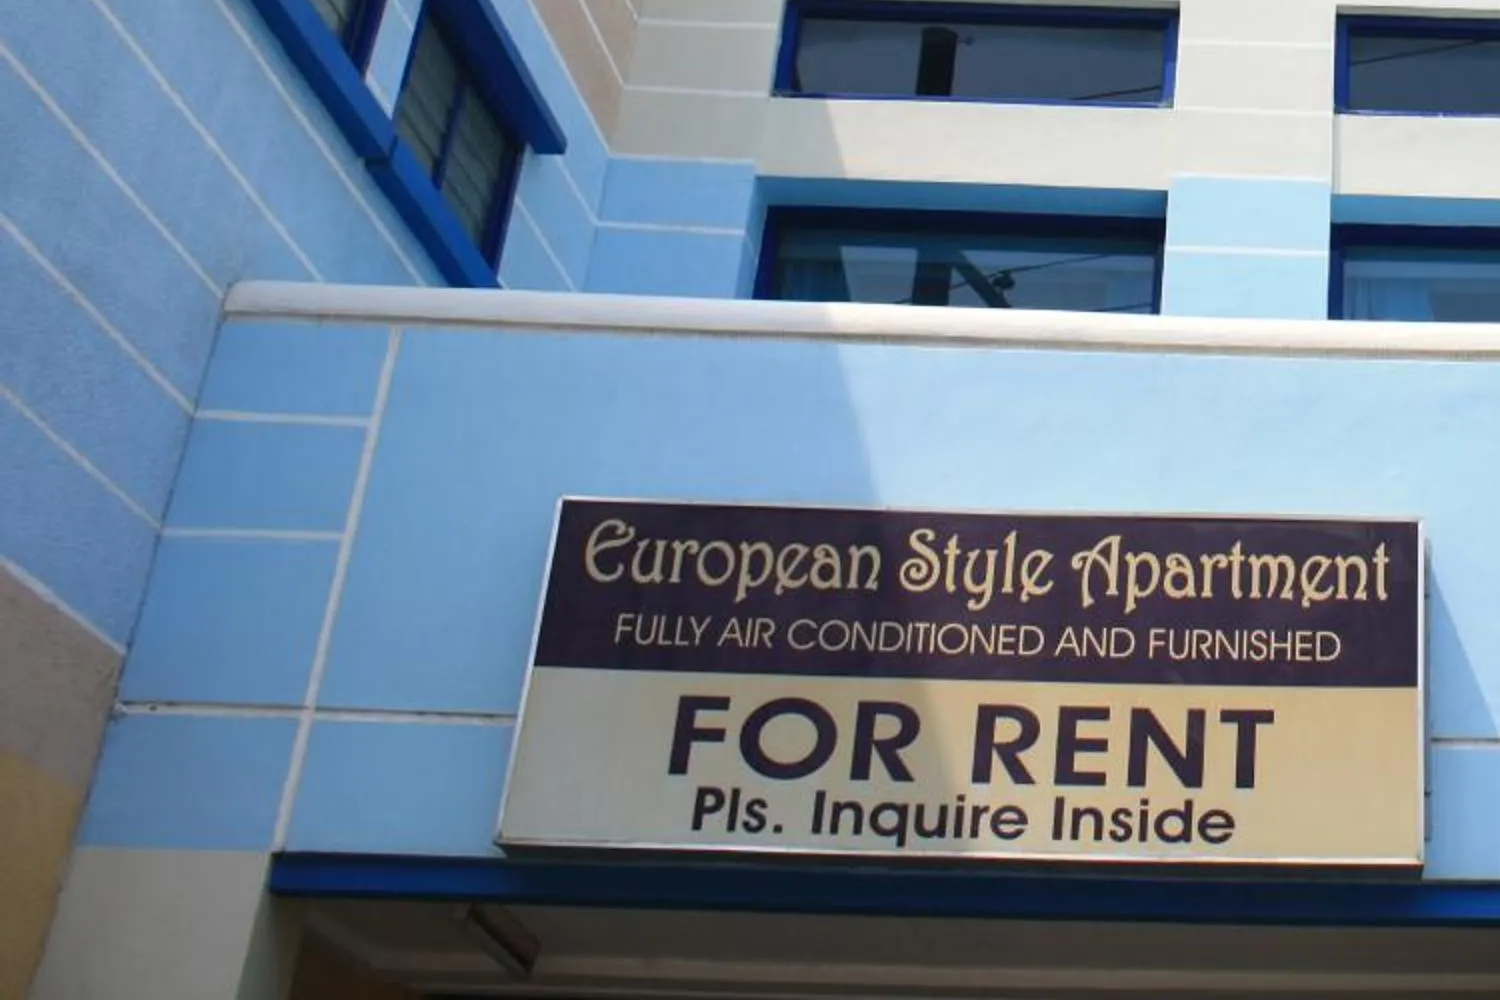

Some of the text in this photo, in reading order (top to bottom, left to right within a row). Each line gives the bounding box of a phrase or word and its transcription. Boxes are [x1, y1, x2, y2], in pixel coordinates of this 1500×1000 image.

[584, 519, 1392, 614] European Style Apartment
[613, 612, 1342, 663] FULLY AIR CONDITIONED AND FURNISHED
[667, 694, 1276, 790] FOR RENT
[690, 786, 1236, 848] Pls. Inquire Inside
